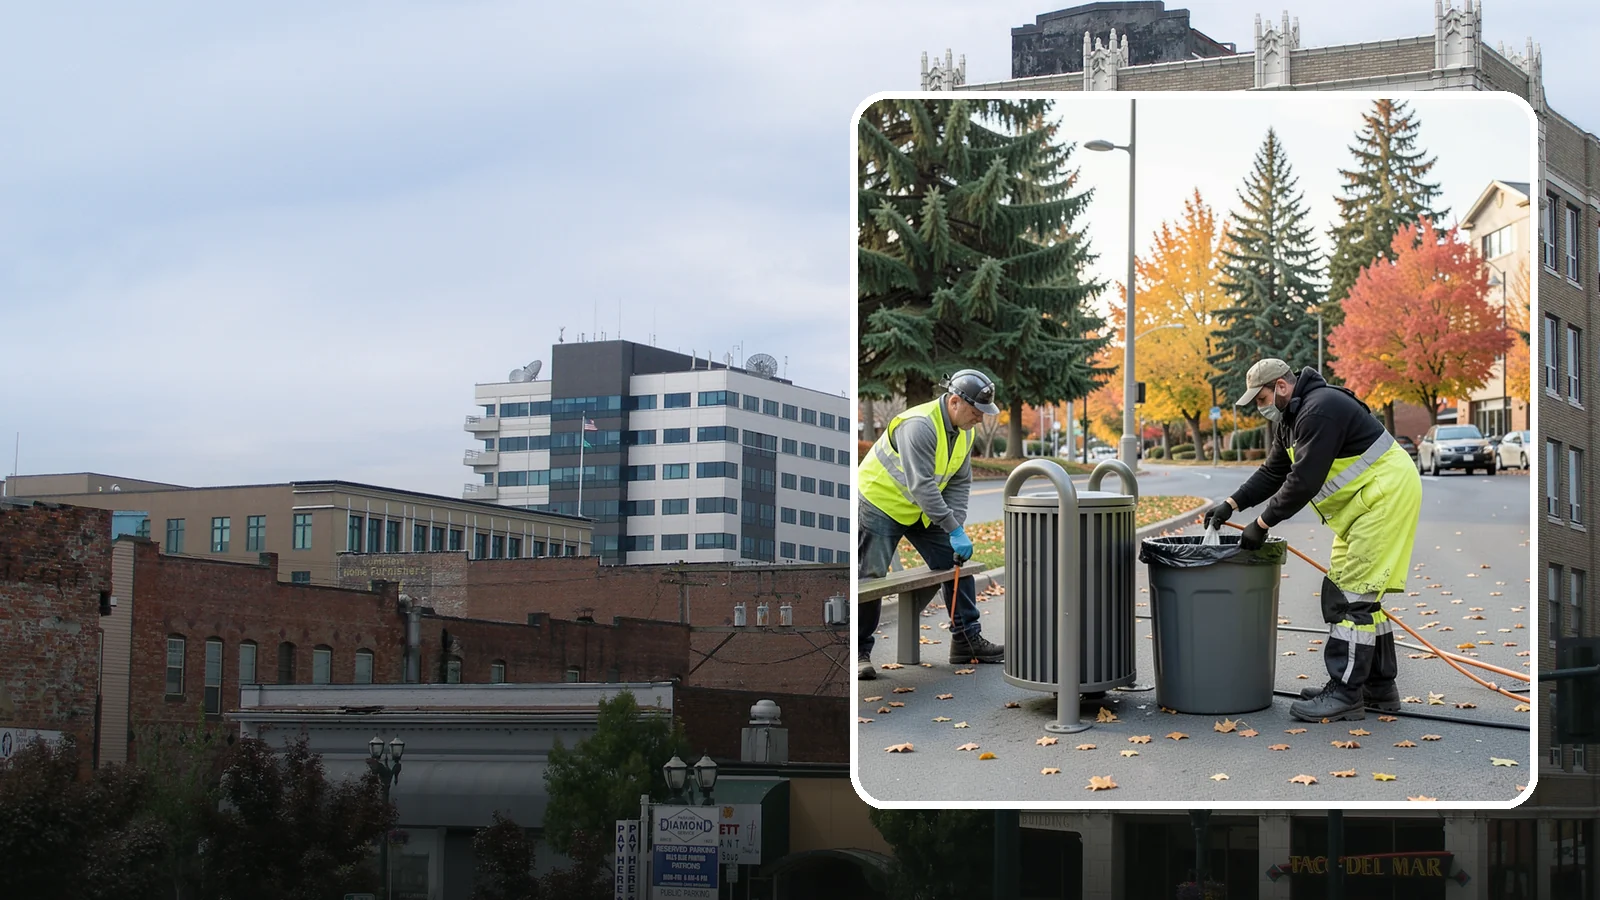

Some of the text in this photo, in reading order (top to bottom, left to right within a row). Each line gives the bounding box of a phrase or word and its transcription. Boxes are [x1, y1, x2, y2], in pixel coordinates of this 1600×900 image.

[370, 565, 427, 577] Furnishers
[660, 818, 713, 833] DIAMOND
[1022, 815, 1069, 828] BUILDING
[656, 845, 716, 854] RESERVED PARKING
[617, 824, 625, 893] PAY HERE
[628, 824, 636, 893] PAY HERE
[721, 851, 739, 861] Soup
[671, 862, 701, 870] PATRONS
[1289, 855, 1442, 877] TAC DEL MAR
[660, 888, 710, 898] PUBLIC PARKING
